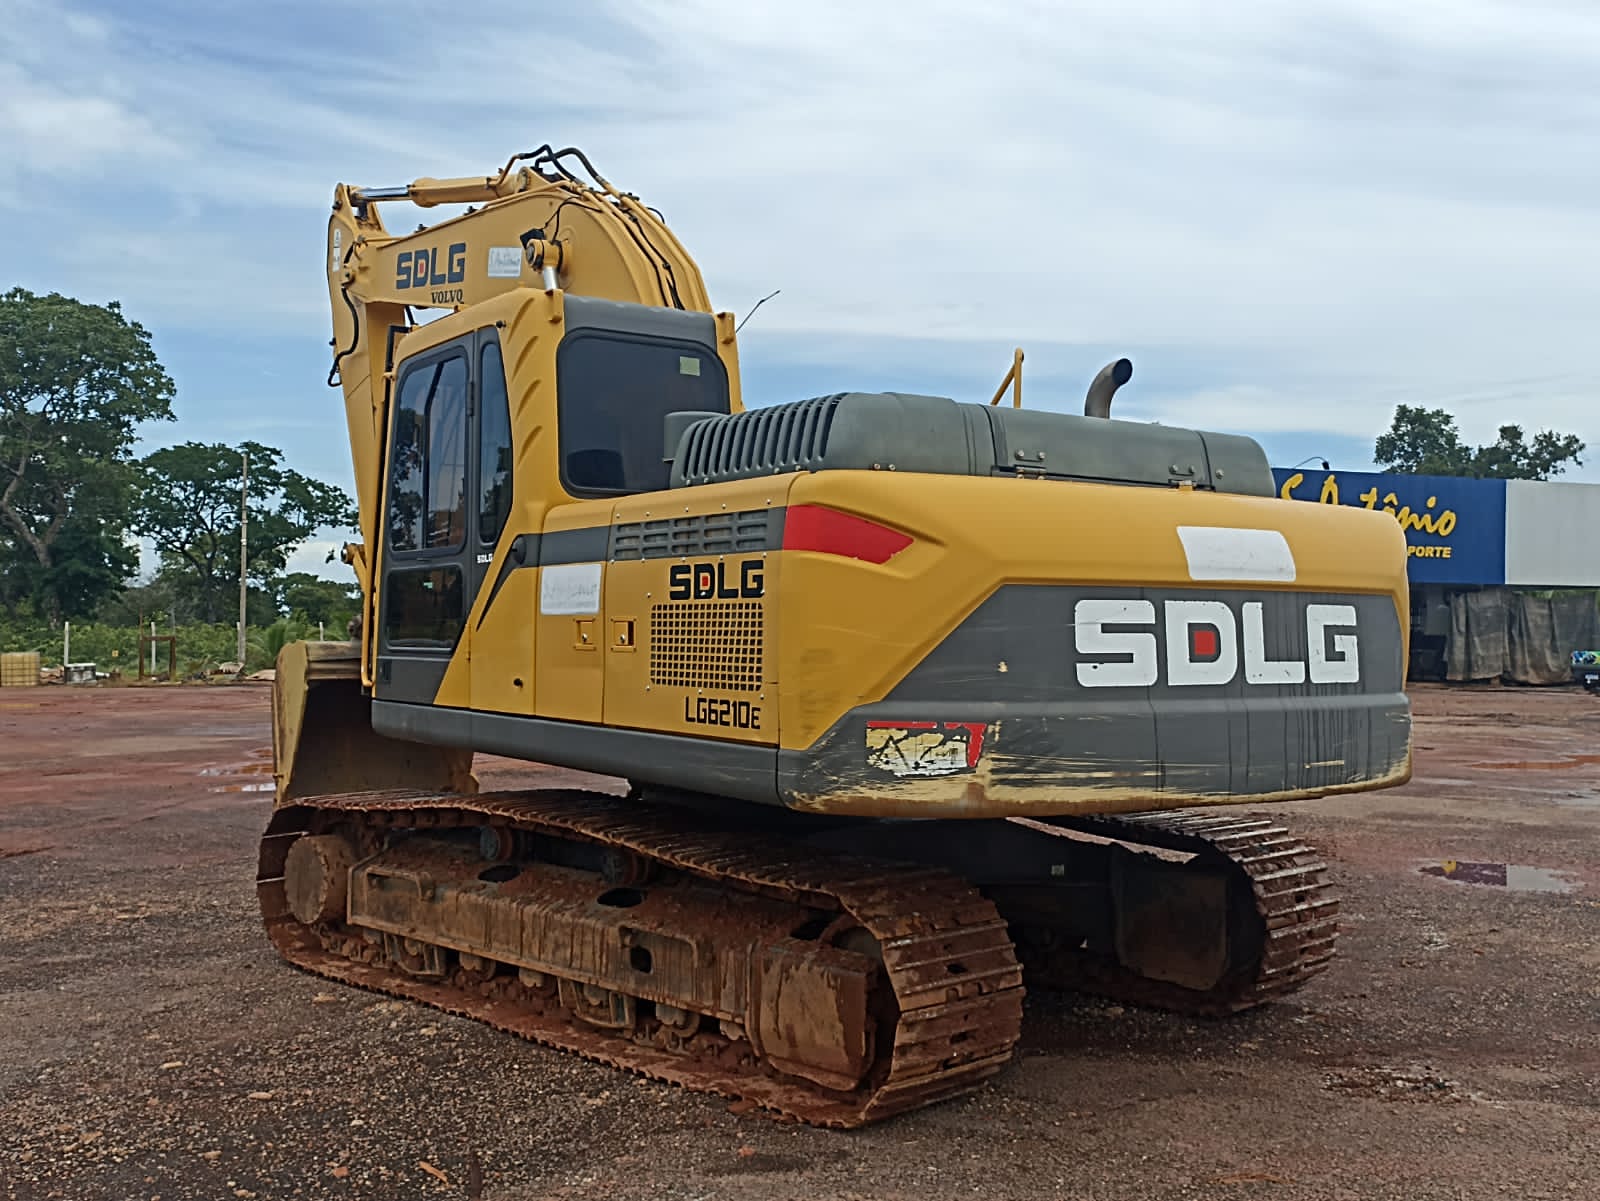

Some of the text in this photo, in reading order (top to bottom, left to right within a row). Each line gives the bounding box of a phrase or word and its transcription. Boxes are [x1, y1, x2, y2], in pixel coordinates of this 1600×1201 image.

[396, 243, 466, 289] SDLG
[670, 560, 764, 600] SDLG
[1074, 599, 1360, 687] SDLG
[685, 696, 760, 729] LG6210E
